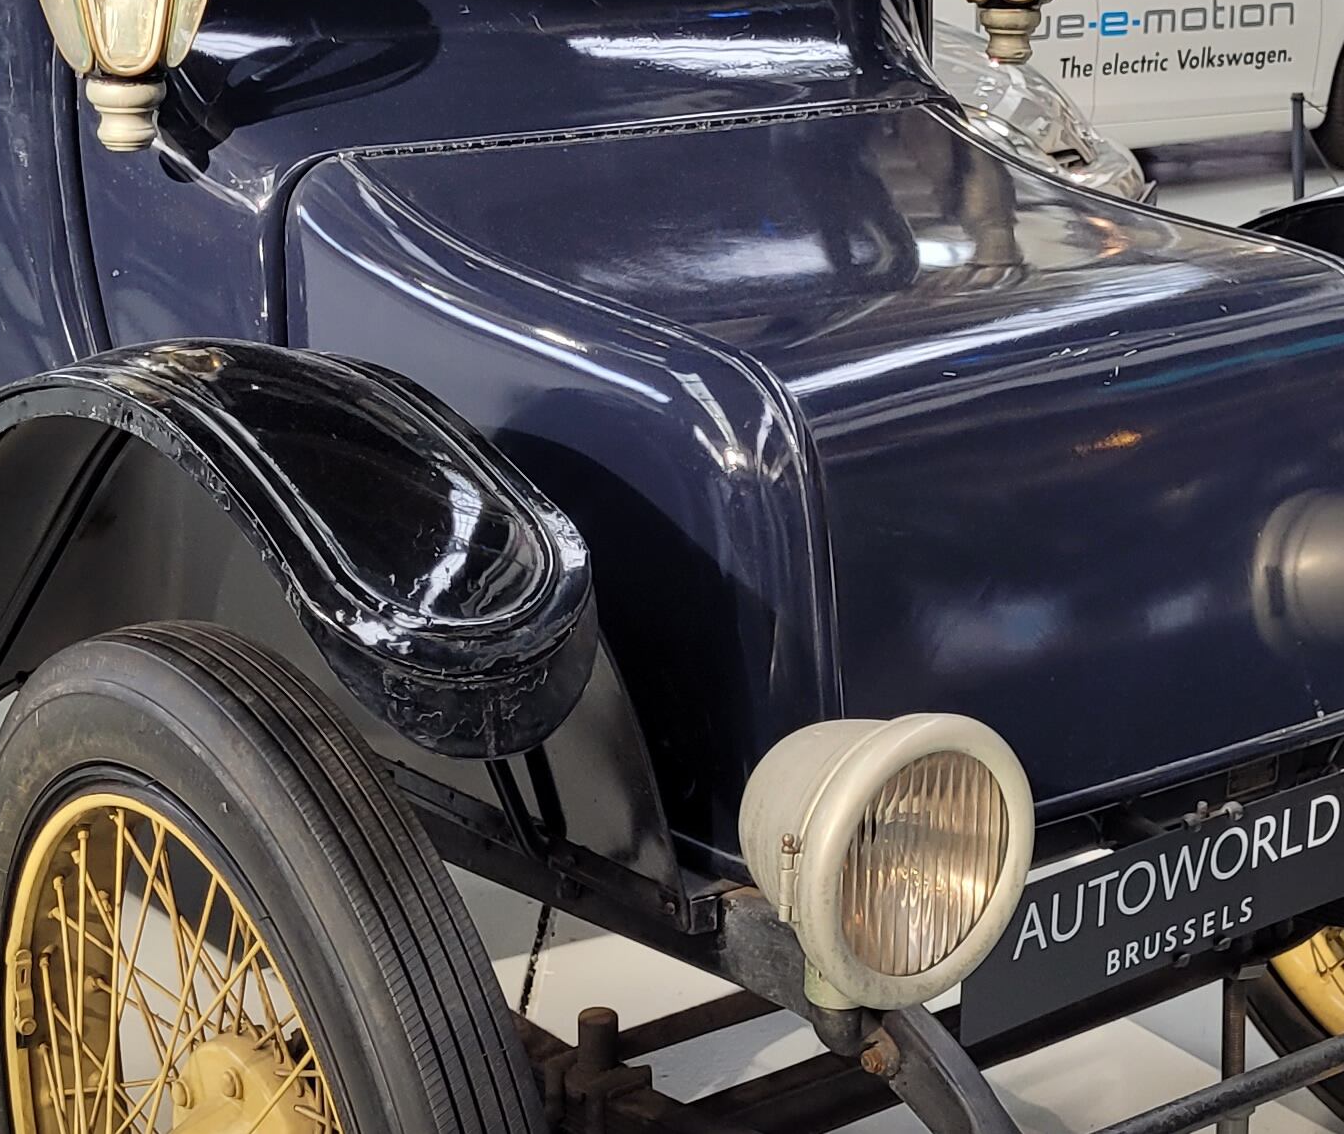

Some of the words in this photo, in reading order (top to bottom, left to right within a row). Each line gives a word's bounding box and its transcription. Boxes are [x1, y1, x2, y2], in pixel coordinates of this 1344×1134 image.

[1060, 57, 1094, 79] The
[1102, 52, 1168, 76] electric
[1177, 46, 1292, 70] Volkswagen.
[1011, 794, 1341, 961] AUTOWORLD
[1105, 896, 1253, 976] BRUSSELS
